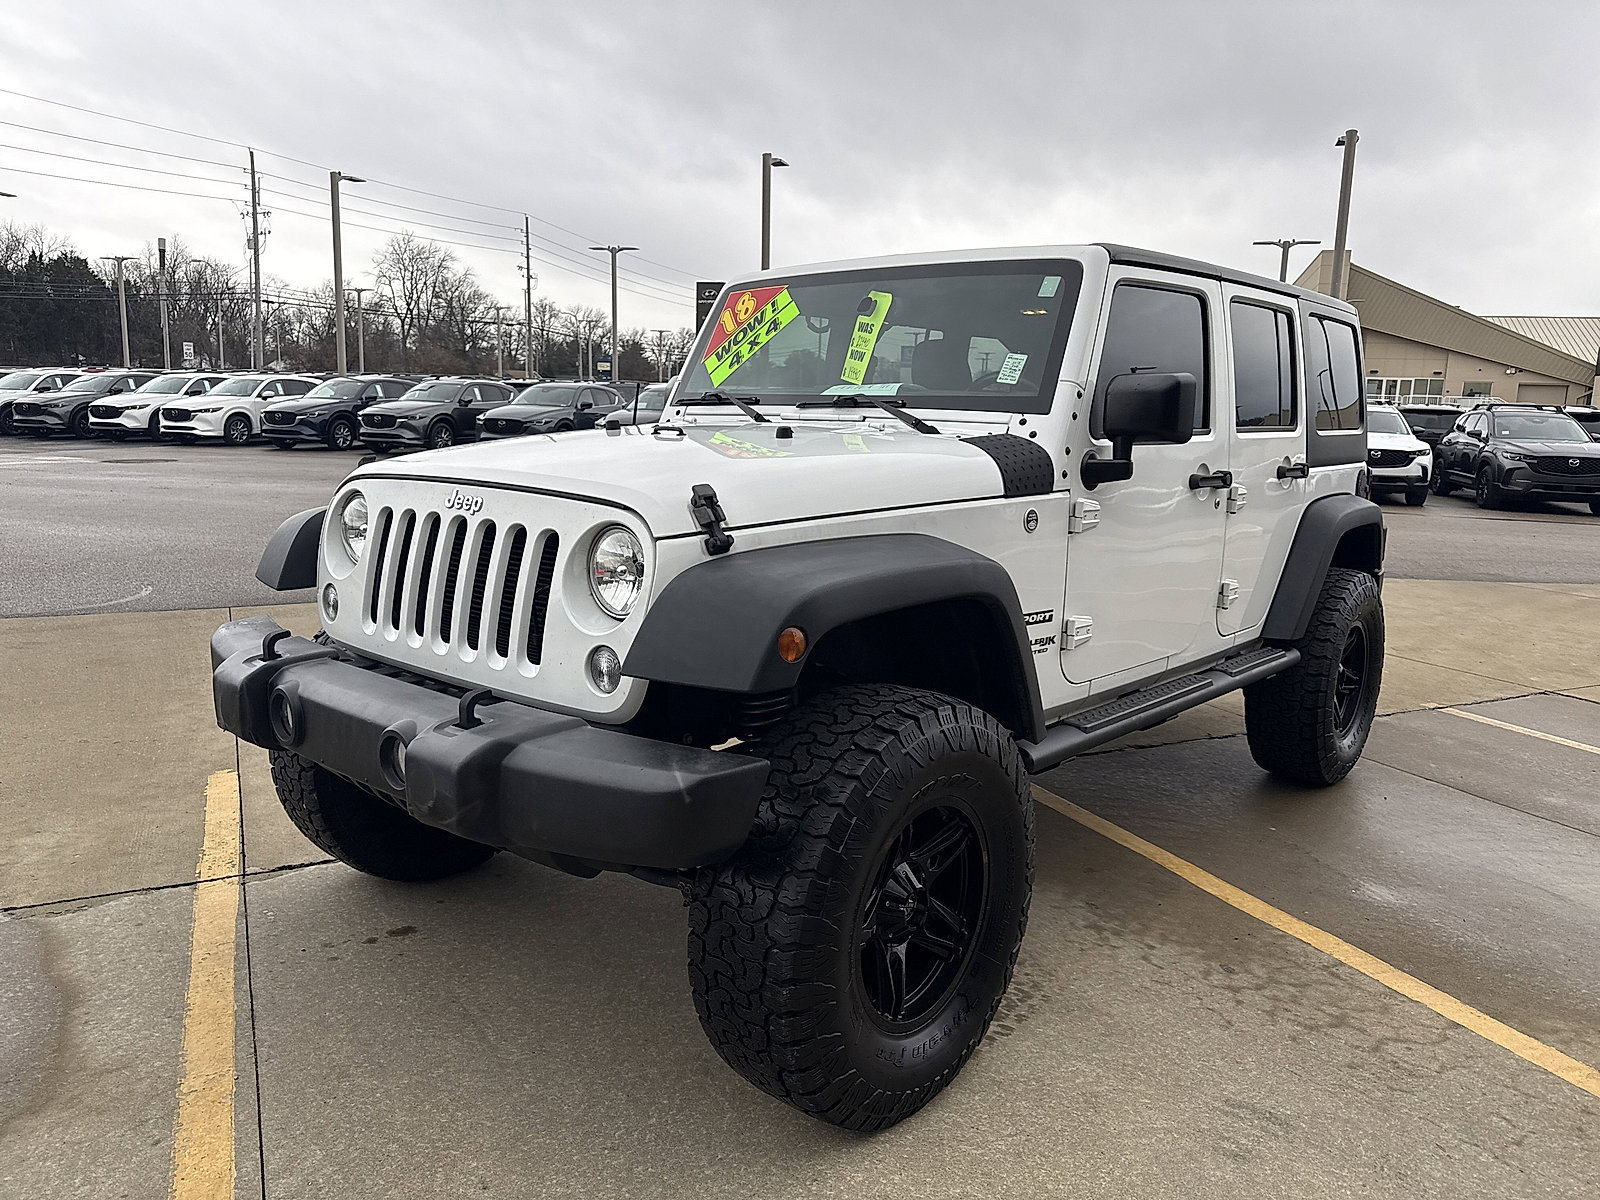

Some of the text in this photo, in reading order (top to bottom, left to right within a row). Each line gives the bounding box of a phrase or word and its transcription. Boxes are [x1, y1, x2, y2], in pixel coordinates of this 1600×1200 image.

[720, 292, 756, 334] 18
[857, 321, 875, 334] WAS
[728, 350, 744, 369] 4
[765, 317, 782, 336] 4
[849, 349, 866, 362] NOW
[444, 488, 484, 516] Jeep
[1024, 613, 1050, 622] PORT
